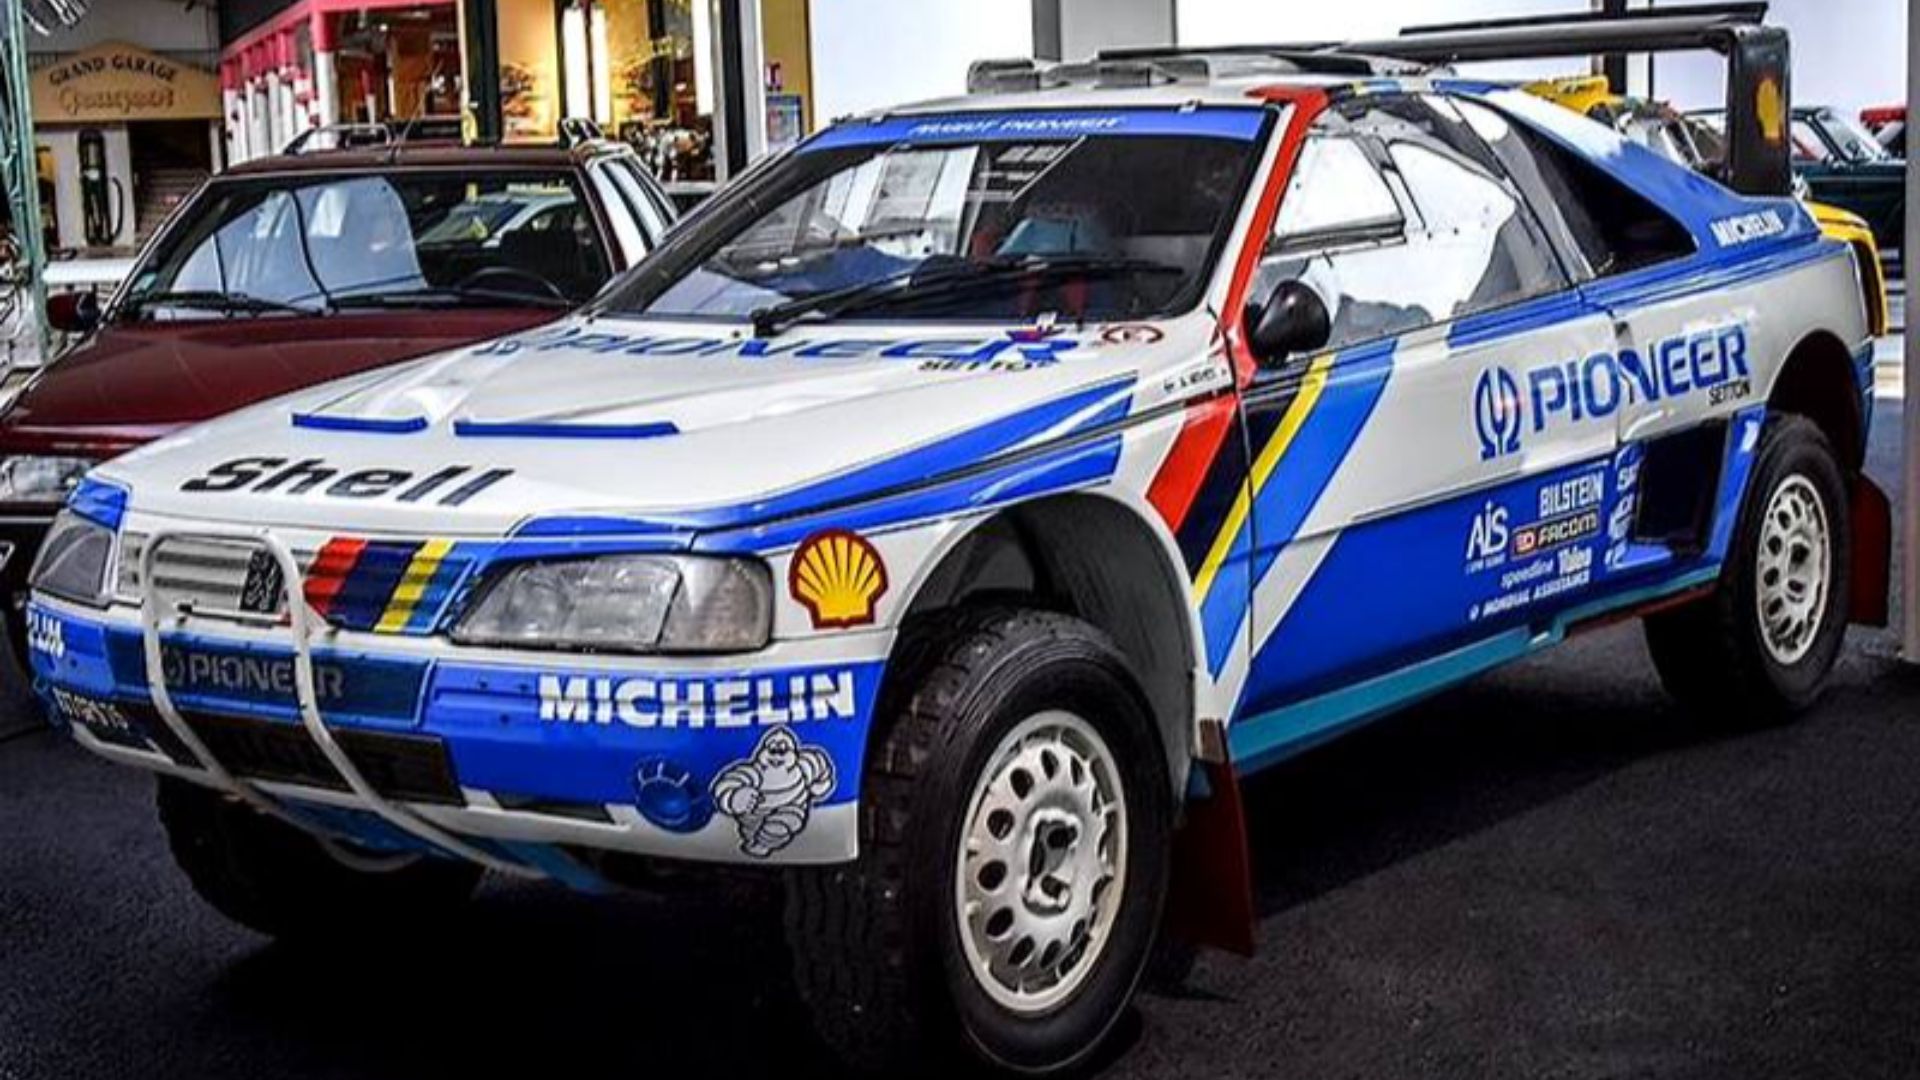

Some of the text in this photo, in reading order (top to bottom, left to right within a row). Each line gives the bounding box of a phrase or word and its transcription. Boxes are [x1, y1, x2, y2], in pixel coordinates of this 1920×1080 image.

[50, 54, 179, 86] GRAND GARAGE
[1709, 208, 1785, 248] MICHELIN
[1527, 322, 1749, 432] PIONEER
[1707, 378, 1752, 407] SETTON
[180, 457, 515, 507] Shell
[1539, 471, 1605, 518] BILSTEIN
[189, 653, 345, 698] PIONER
[539, 670, 856, 728] MICHELIN
